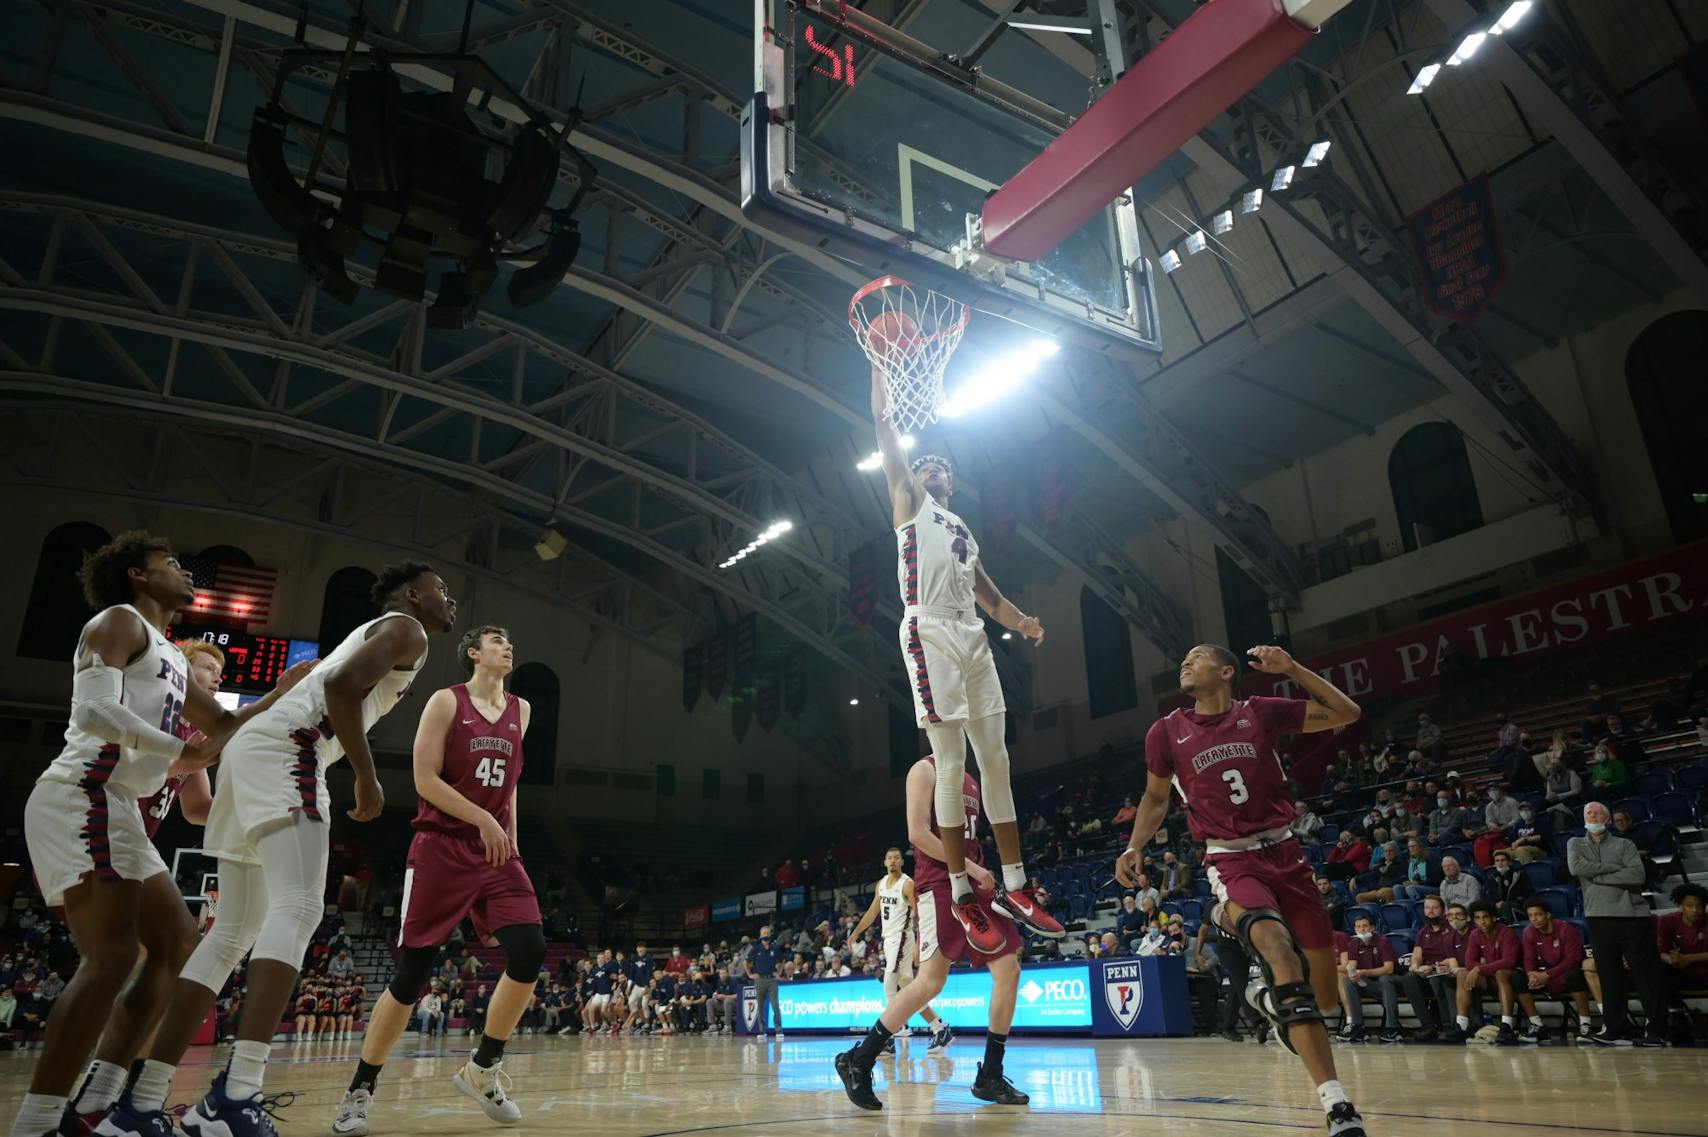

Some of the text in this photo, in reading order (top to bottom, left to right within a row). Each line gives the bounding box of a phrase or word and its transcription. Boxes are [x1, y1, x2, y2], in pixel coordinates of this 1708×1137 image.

[1395, 571, 1708, 684] PALESTR
[470, 736, 513, 757] LAFAYETTE
[1192, 742, 1257, 775] LAFAYETTE
[475, 757, 507, 787] 45
[1222, 769, 1249, 805] 3
[880, 896, 898, 905] PENN
[884, 906, 890, 921] 5
[1107, 965, 1137, 980] PENN
[795, 1000, 828, 1019] powers
